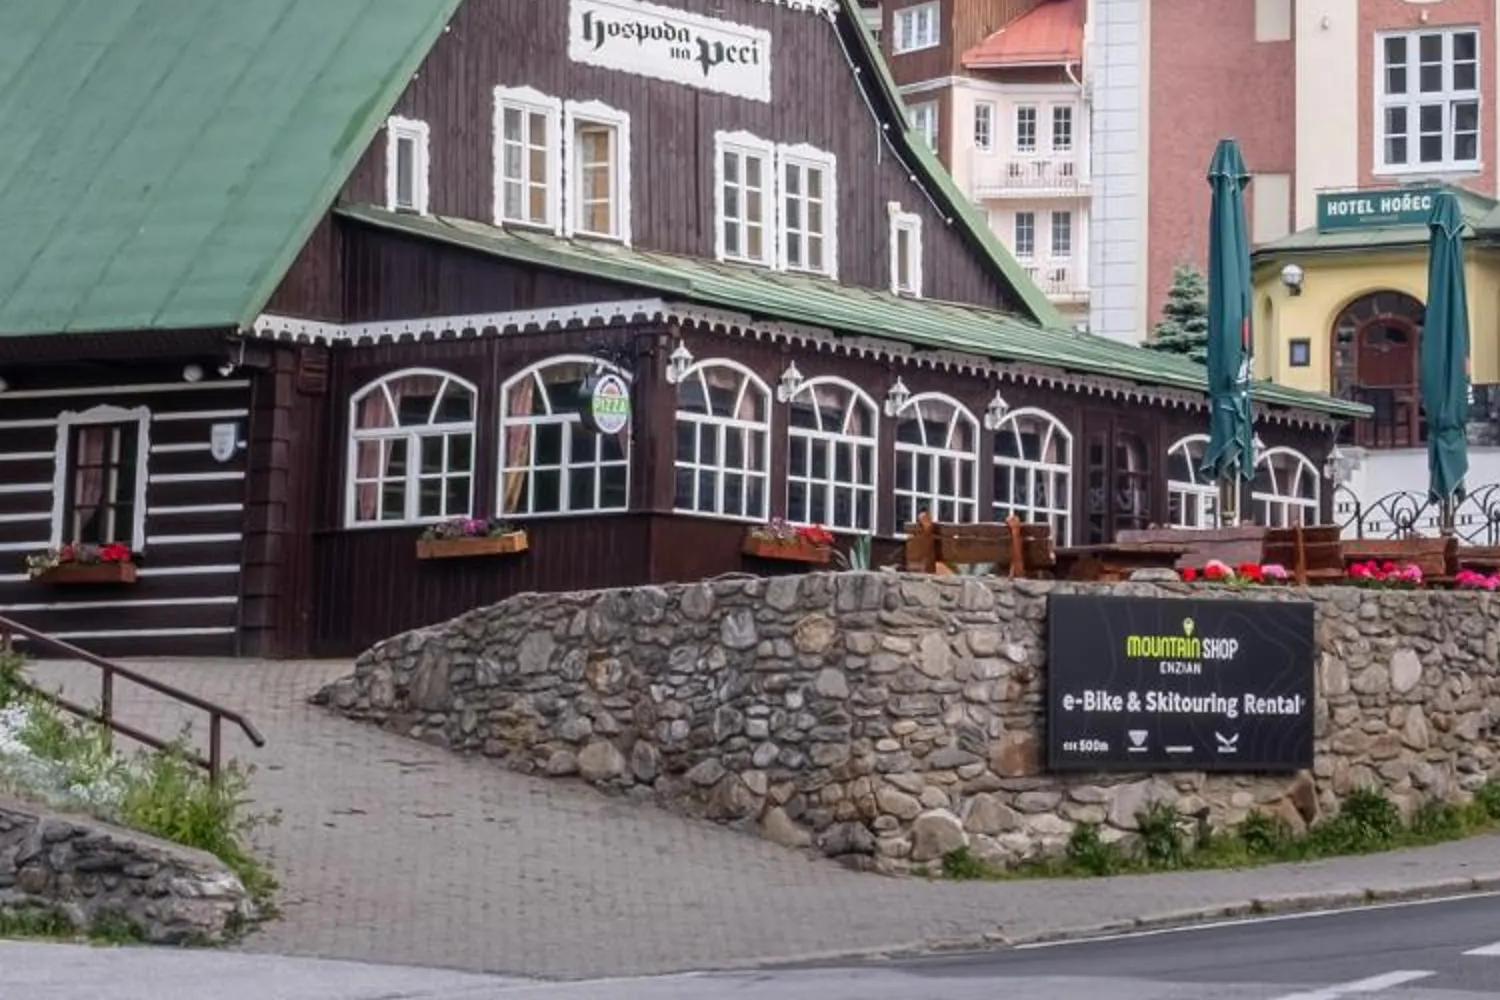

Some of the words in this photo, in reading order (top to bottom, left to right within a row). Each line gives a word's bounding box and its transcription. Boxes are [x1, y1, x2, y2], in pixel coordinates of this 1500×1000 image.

[670, 46, 691, 60] na
[1327, 199, 1375, 216] HOTEL
[1380, 193, 1432, 213] HOŘEC
[1202, 638, 1239, 660] SHOP
[1159, 661, 1202, 675] ENZIAN
[1063, 690, 1123, 713] e-Bike
[1127, 691, 1141, 713] &
[1145, 690, 1238, 719] Skitouring
[1244, 692, 1300, 715] Rental
